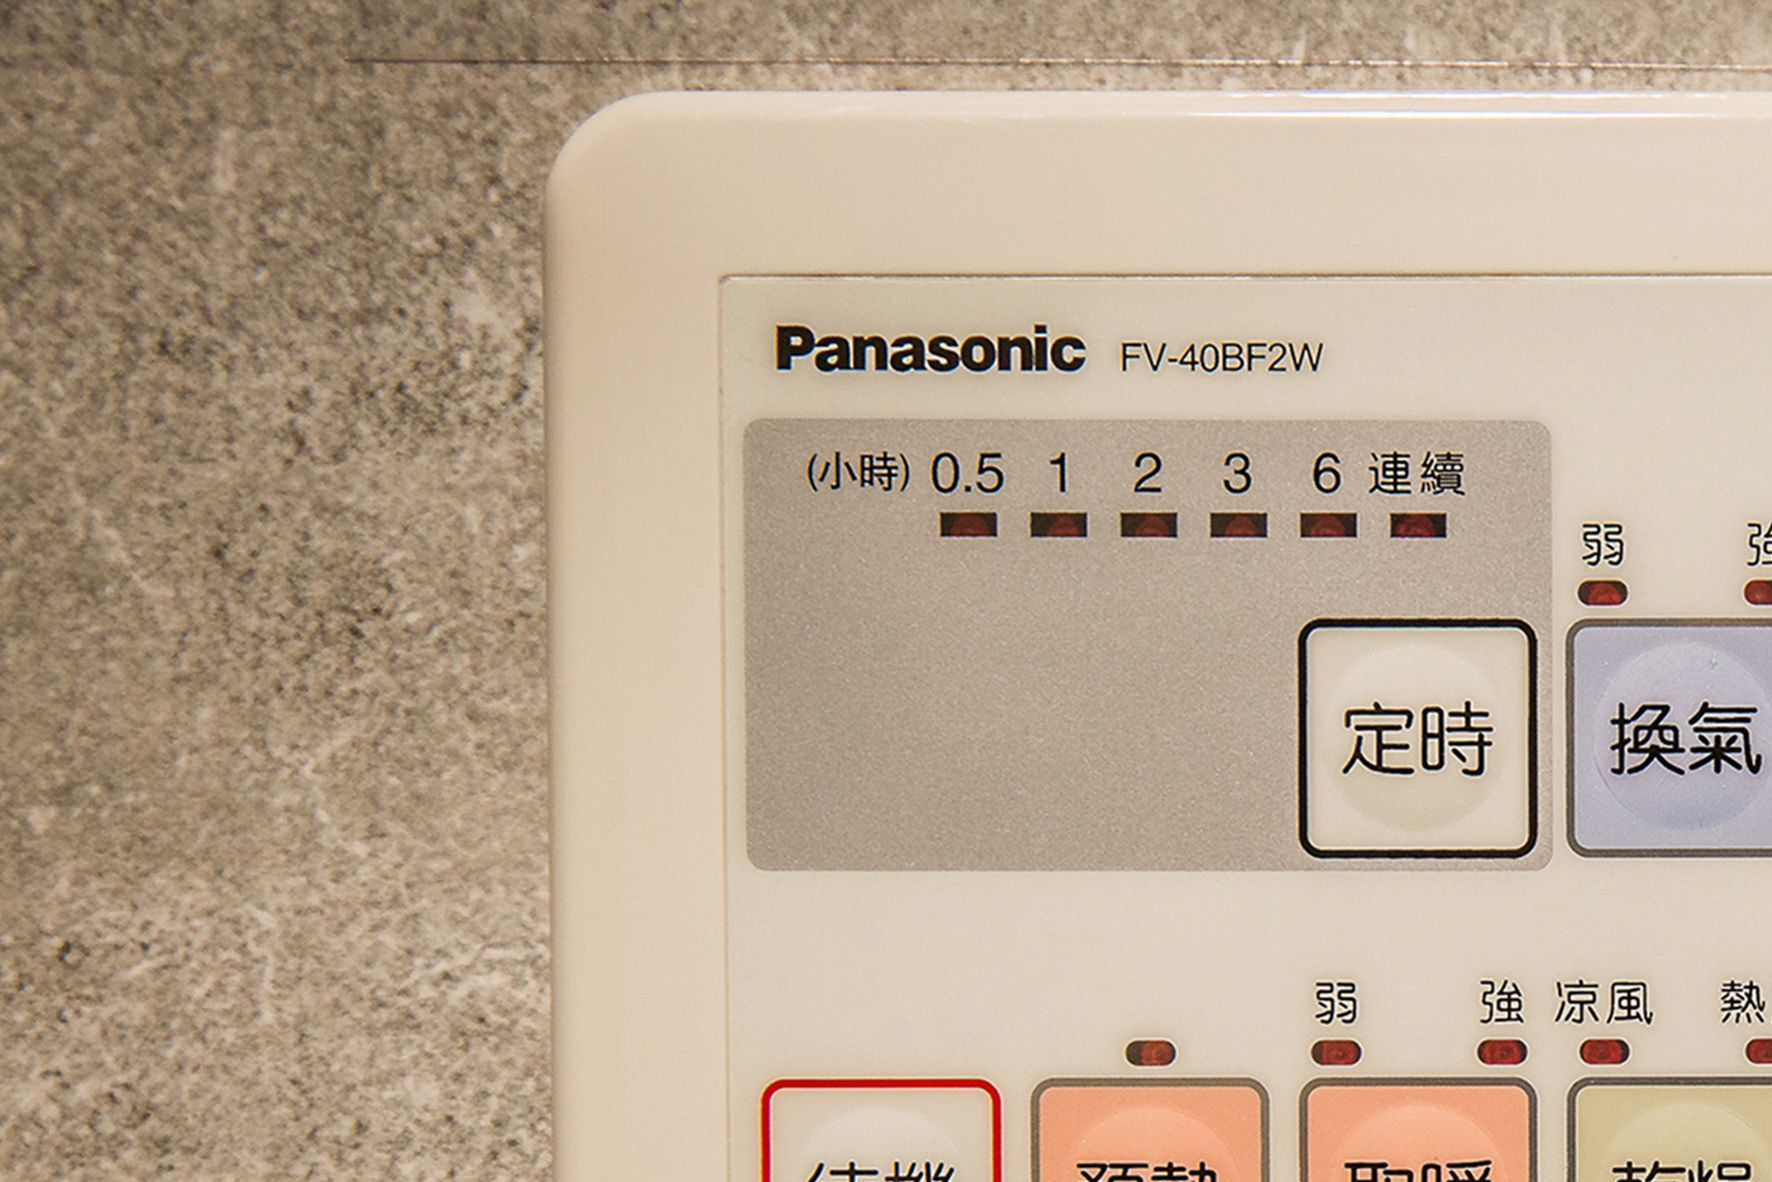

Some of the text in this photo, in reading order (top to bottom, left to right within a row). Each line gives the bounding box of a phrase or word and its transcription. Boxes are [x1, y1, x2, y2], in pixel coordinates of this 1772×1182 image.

[775, 323, 1325, 374] Panasonic FV-40BF2W
[805, 450, 1467, 497] (小時) 0.5 1 2 3 6 連續
[1581, 522, 1625, 568] 弱
[1341, 699, 1495, 778] 定時
[1609, 700, 1763, 777] 換氣
[1314, 981, 1358, 1026] 弱
[1479, 978, 1525, 1025] 強
